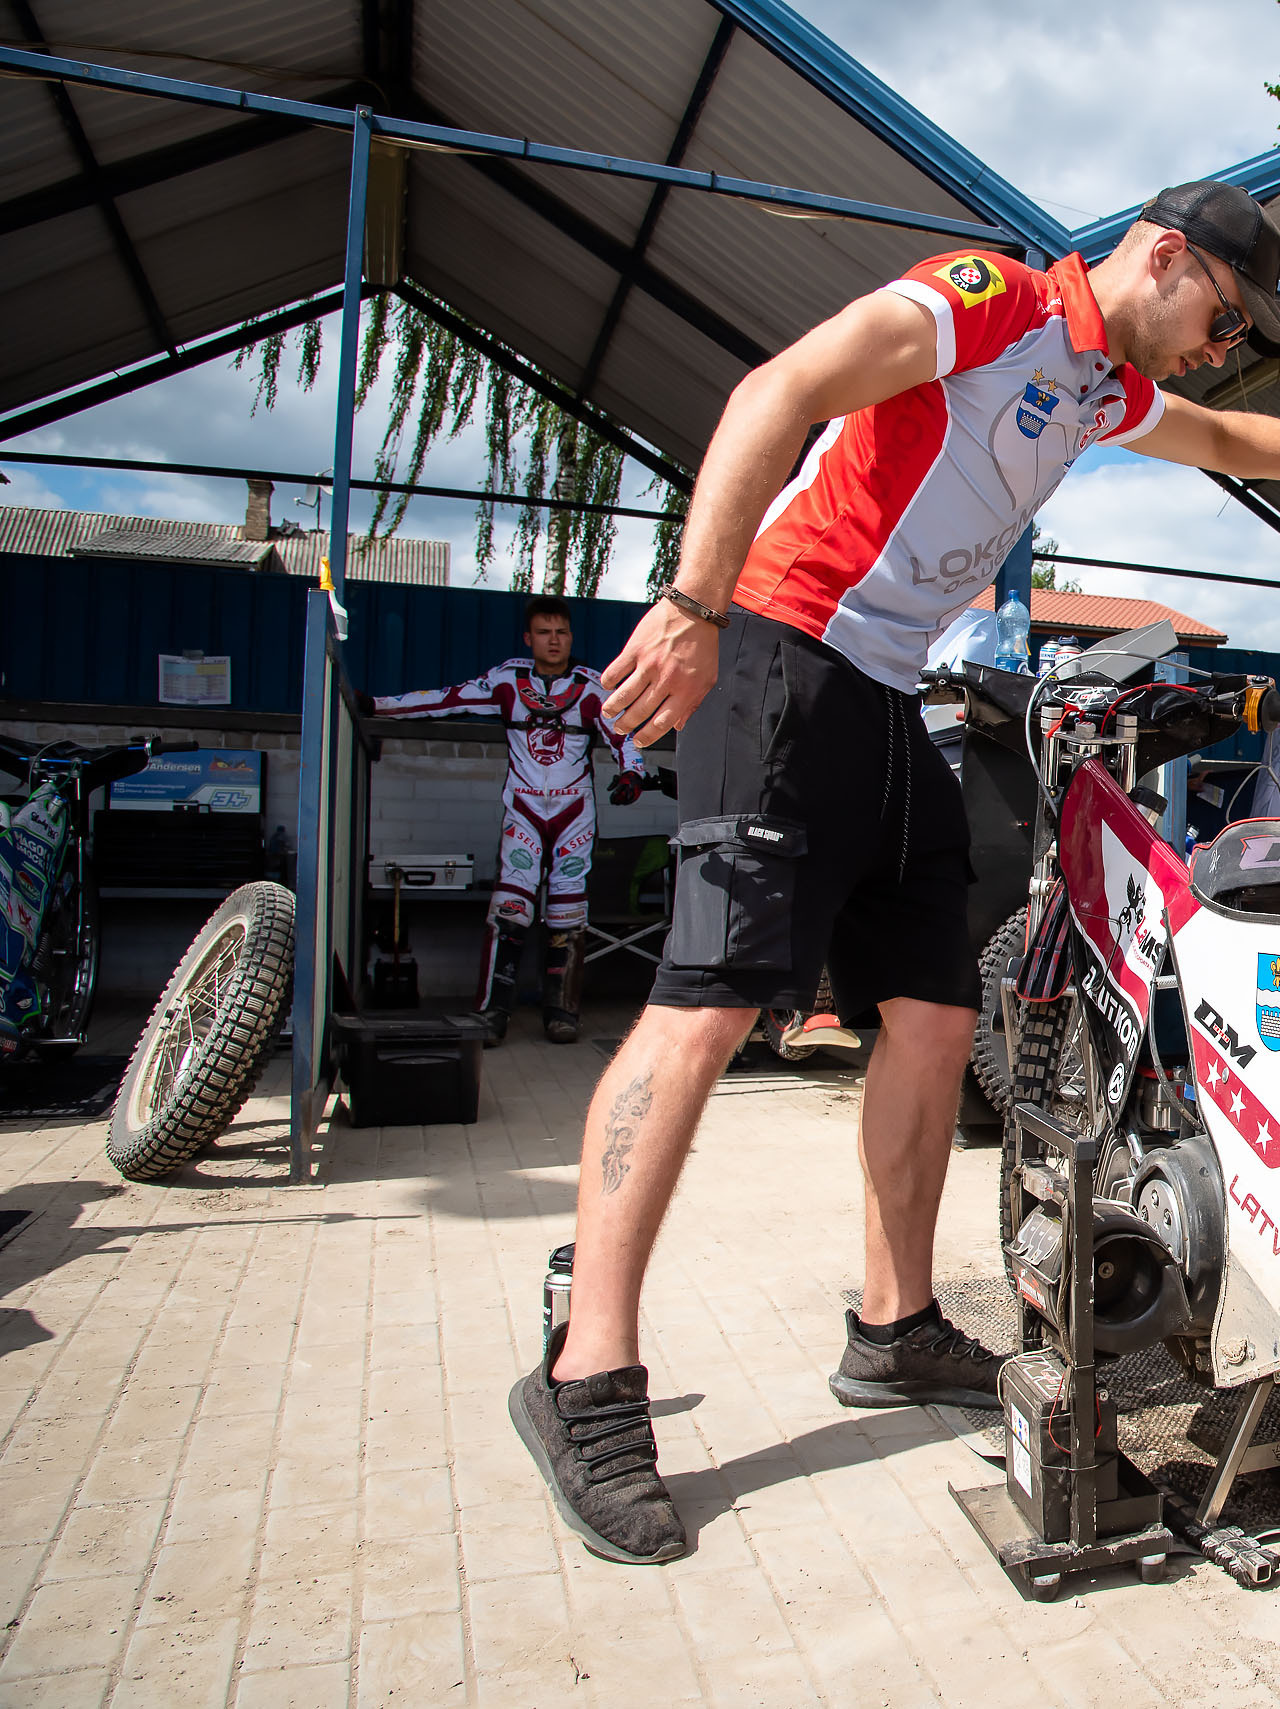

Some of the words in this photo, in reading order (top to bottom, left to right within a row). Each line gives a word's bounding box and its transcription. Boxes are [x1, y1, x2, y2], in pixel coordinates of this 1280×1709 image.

[951, 273, 969, 291] PZM
[211, 792, 249, 807] 34
[514, 787, 545, 797] HANSA
[517, 832, 542, 855] SELS
[569, 830, 594, 849] SELS
